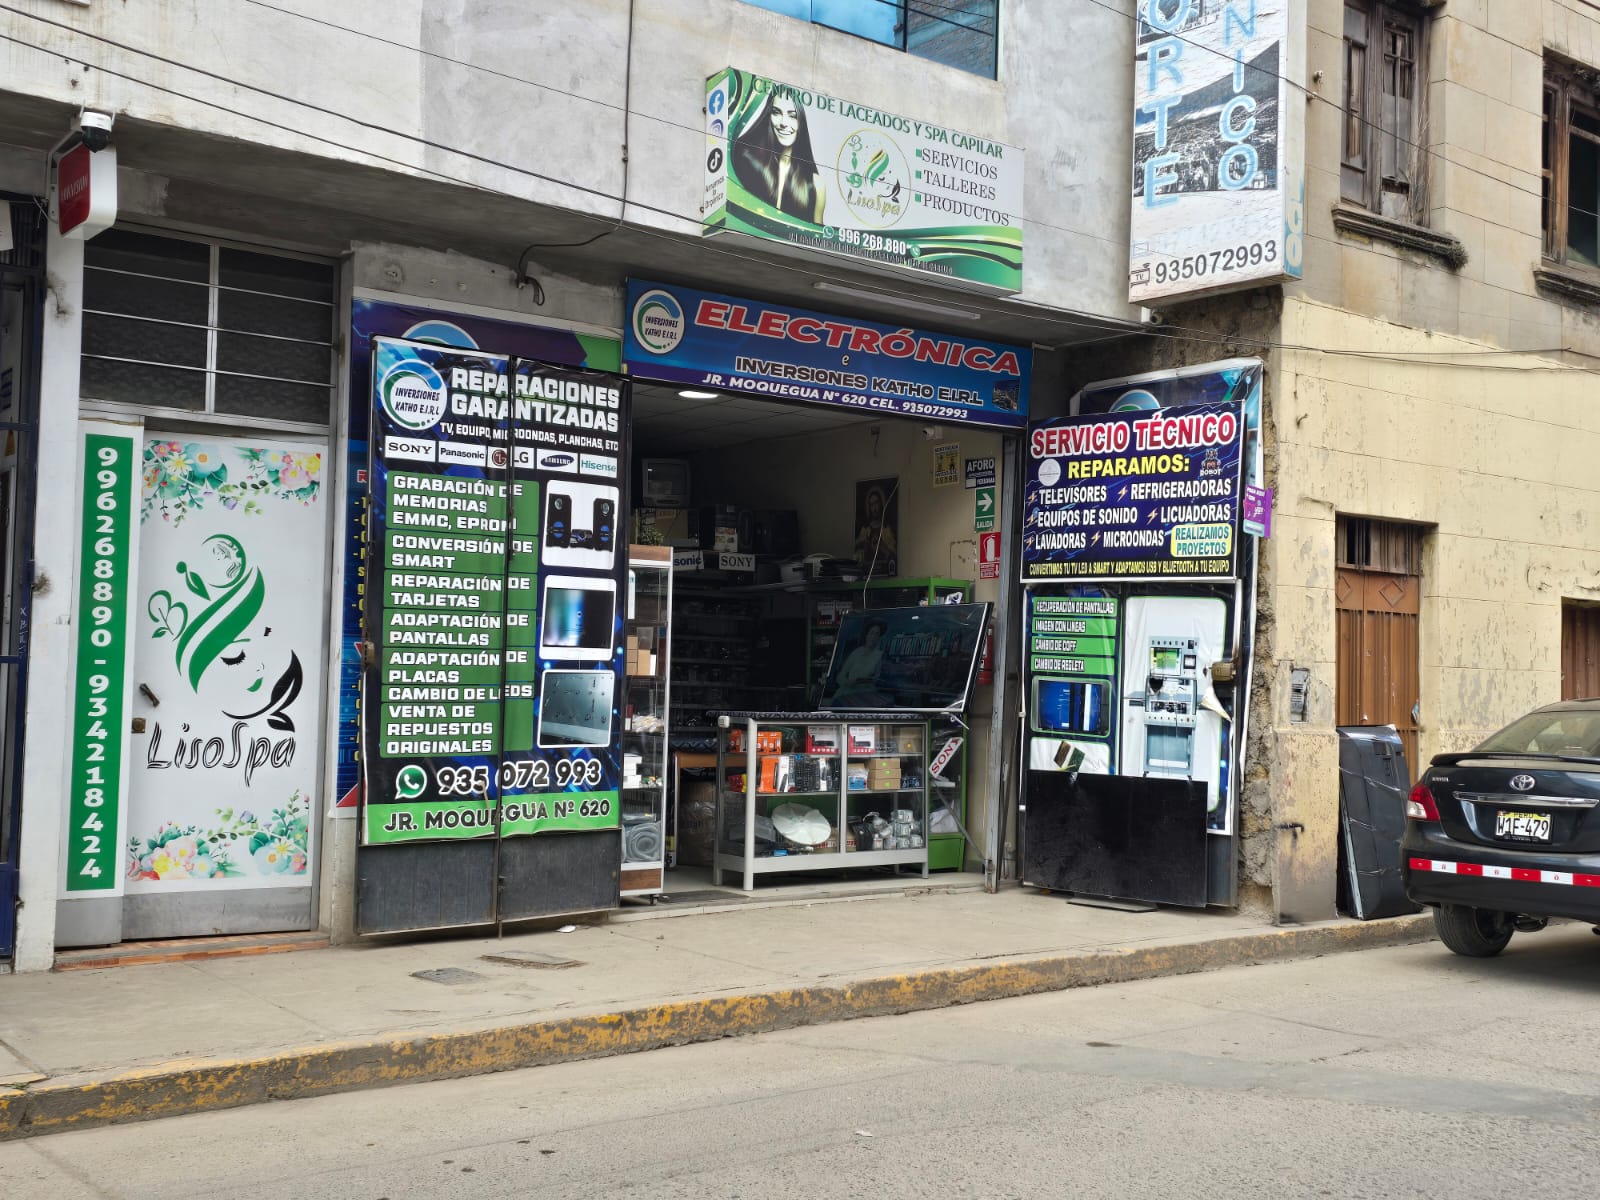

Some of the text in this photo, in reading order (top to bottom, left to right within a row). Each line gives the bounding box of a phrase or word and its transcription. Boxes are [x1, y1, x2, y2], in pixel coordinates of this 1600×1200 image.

[752, 78, 1003, 159] CENTRO DE LACEADOS Y SPA CAPILAR
[922, 148, 998, 180] SERVICIOS
[924, 169, 996, 200] TALLERES
[923, 194, 1010, 226] PRODUCTOS
[838, 227, 860, 245] 996
[863, 232, 882, 249] 268
[1155, 240, 1277, 284] 935072993
[694, 299, 1021, 376] ELECTRÓNICA
[842, 354, 850, 366] e
[735, 355, 867, 390] INVERSIONES
[872, 377, 933, 400] KATHO
[395, 386, 440, 401] INVERSIONES
[452, 367, 620, 409] REPARACIONES
[702, 373, 726, 386] JR.
[729, 376, 820, 400] MOQUEGUA
[842, 393, 867, 406] 620
[870, 396, 899, 410] CEL.
[902, 402, 968, 418] 935072993
[394, 403, 418, 413] KATHO
[451, 393, 619, 433] GARANTIZADAS
[440, 422, 454, 435] TV,
[559, 433, 604, 451] PLANCHAS,
[605, 440, 619, 451] ETC
[1030, 411, 1237, 459] SERVICIO TÉCNICO
[388, 442, 433, 455] SONY
[440, 448, 485, 460] Panasonic
[581, 460, 617, 472] Hisense
[966, 459, 994, 472] AFORO
[1067, 453, 1190, 479] REPARAMOS:
[393, 474, 523, 498] GRABACIÓN DE
[1039, 485, 1107, 505] TELEVISORES
[1130, 478, 1231, 500] REFRIGERADORAS
[393, 494, 487, 513] MEMORIAS
[392, 511, 452, 531] EMMC,
[1037, 504, 1231, 528] EQUIPOS DE SONIDO LICUADORAS
[1035, 530, 1165, 550] LAVADORAS MICROONDAS
[1175, 526, 1229, 541] REALIZAMOS
[392, 534, 533, 555] CONVERSIÓN DE
[1176, 541, 1227, 556] PROYECTOS
[391, 553, 456, 569] SMART
[720, 556, 753, 567] SONY
[1029, 562, 1062, 576] CONVERTIMOS
[1064, 562, 1071, 575] TU
[1071, 562, 1079, 575] TV
[1089, 562, 1093, 574] A
[1093, 561, 1110, 574] SMART
[1110, 561, 1115, 573] Y
[1115, 561, 1145, 574] ADAPTAMOS
[1146, 561, 1157, 573] USB
[1158, 561, 1163, 573] Y
[1163, 560, 1194, 573] BLUETOOTH
[1194, 560, 1199, 573] A
[1200, 560, 1208, 573] TU
[1208, 560, 1229, 573] EQUIPO
[391, 573, 531, 591] REPARACIÓN DE
[391, 592, 480, 608] TARJETAS
[1076, 602, 1083, 613] DE
[1084, 602, 1114, 614] PANTALLAS
[390, 613, 529, 629] ADAPTACIÓN DE
[1035, 620, 1054, 632] IMAGEN
[1055, 620, 1066, 632] CON
[389, 631, 490, 646] PANTALLAS
[1035, 638, 1054, 651] CAMBIO
[1055, 639, 1062, 651] DE
[80, 447, 119, 879] 996268890-934218424
[389, 650, 528, 667] ADAPTACIÓN DE
[1034, 658, 1054, 670] CAMBIO
[1054, 659, 1062, 670] DE
[388, 670, 460, 683] PLACAS
[388, 685, 533, 701] CAMBIO DE LEDS
[388, 705, 475, 718] VENTA DE
[387, 722, 493, 736] REPUESTOS
[146, 721, 297, 787] LisoSpa
[386, 740, 492, 755] ORIGINALES
[931, 739, 958, 774] SONY
[436, 759, 602, 795] 935 072 993
[384, 812, 418, 832] JR.
[424, 801, 549, 831] MOQUEGUA
[579, 799, 611, 817] 620
[1497, 816, 1550, 837] W1F-479
